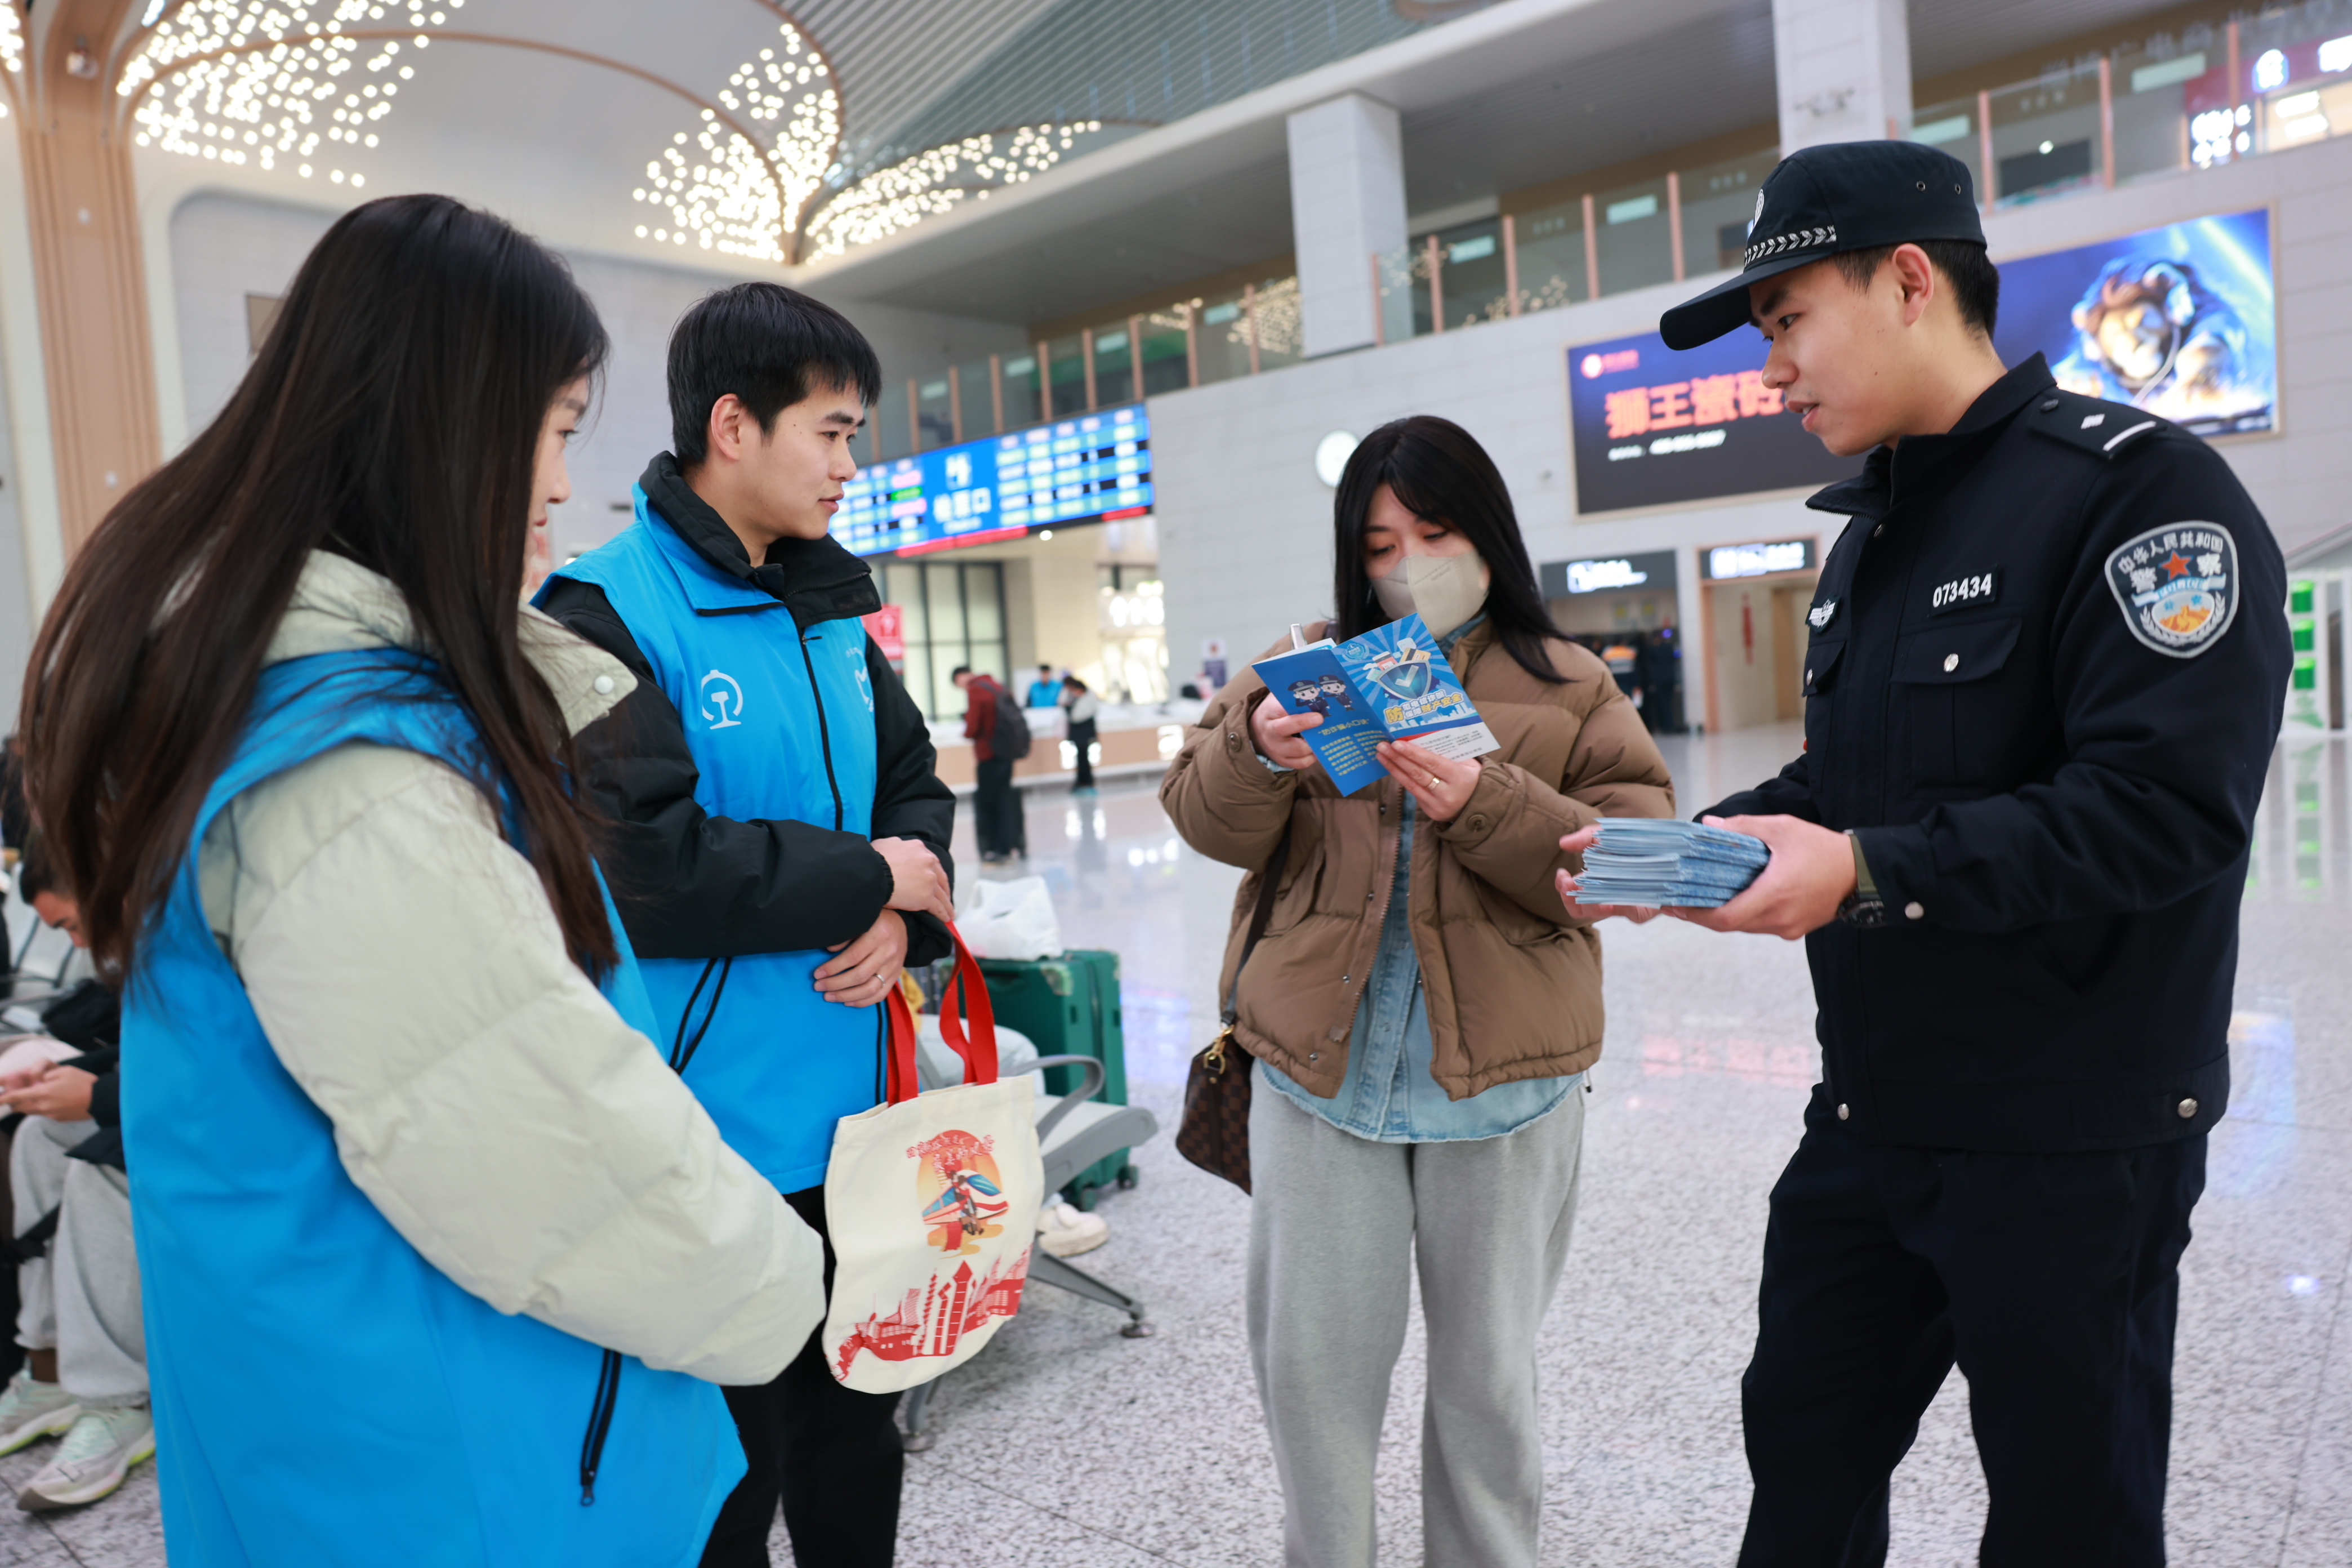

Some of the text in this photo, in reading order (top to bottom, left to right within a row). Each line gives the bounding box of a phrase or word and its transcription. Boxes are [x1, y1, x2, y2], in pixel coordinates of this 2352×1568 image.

[2118, 531, 2223, 574] 中华人民共和国
[1932, 572, 1992, 608] 073434
[2130, 567, 2157, 593] 警
[2197, 553, 2221, 577] 察
